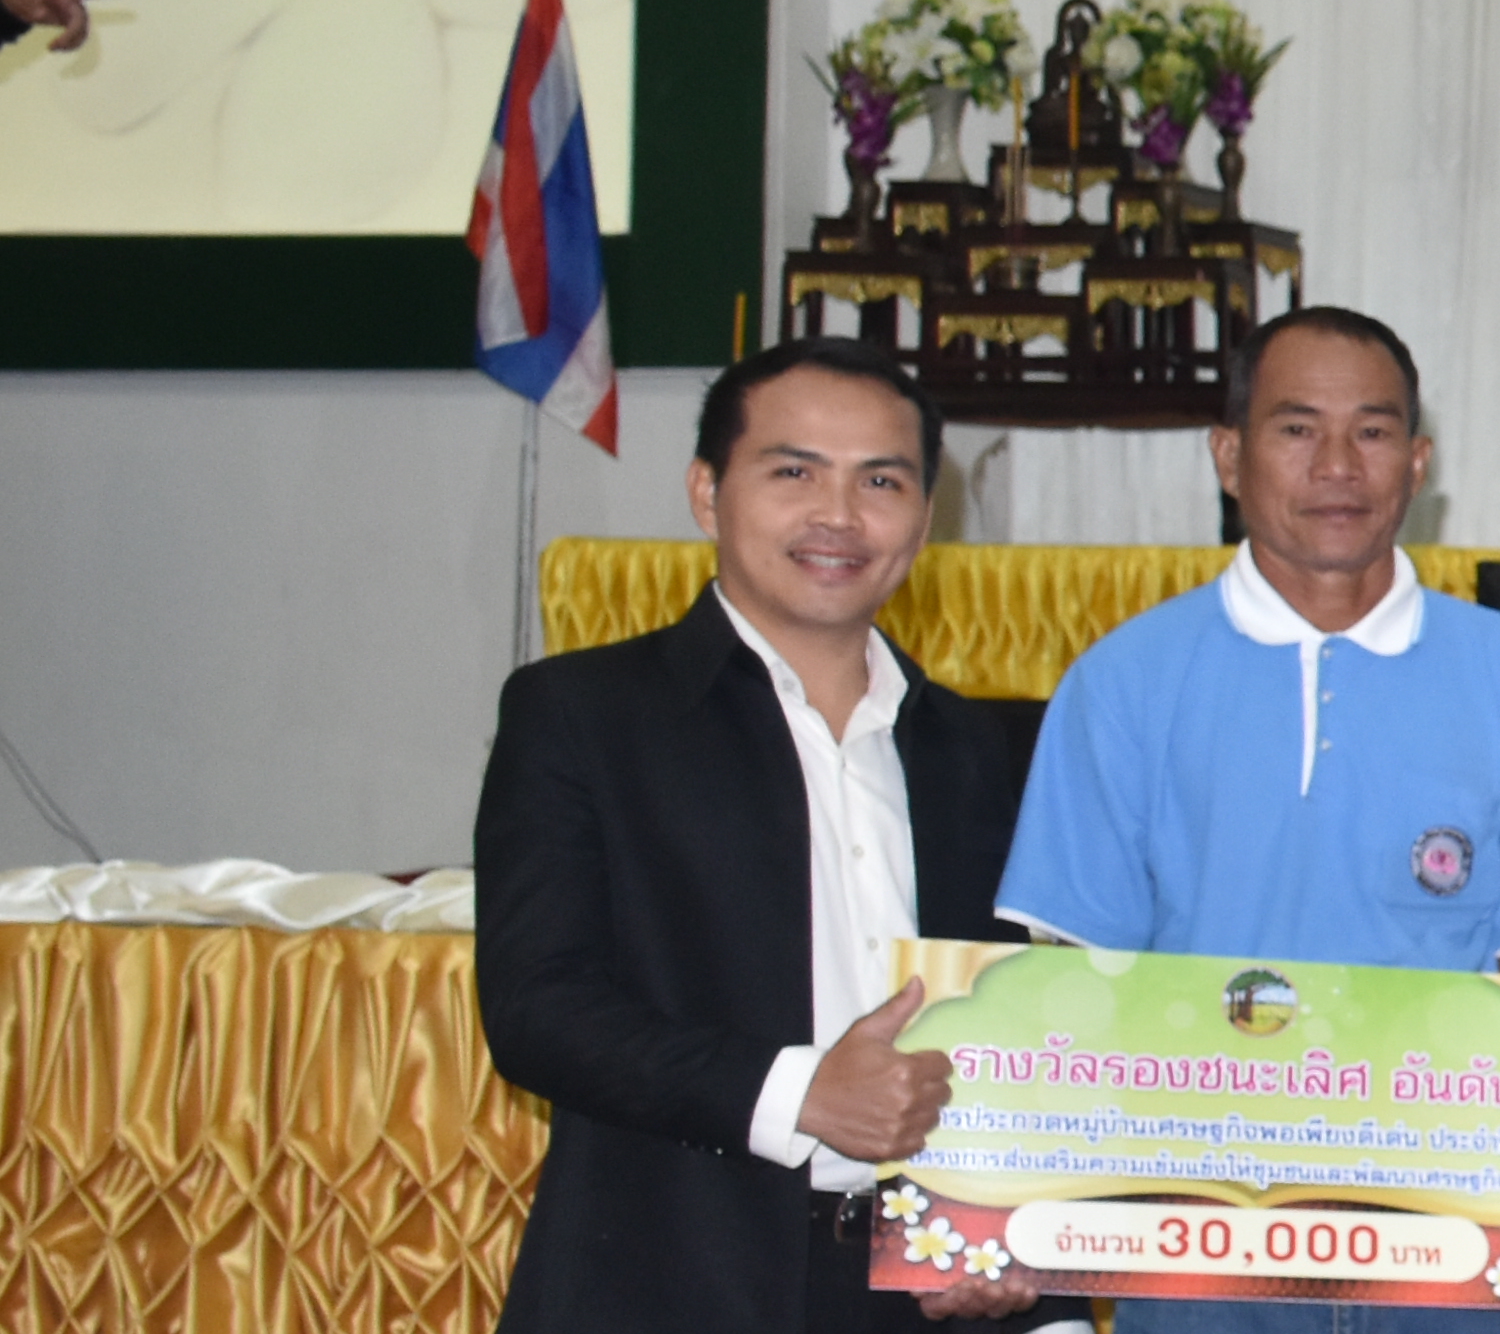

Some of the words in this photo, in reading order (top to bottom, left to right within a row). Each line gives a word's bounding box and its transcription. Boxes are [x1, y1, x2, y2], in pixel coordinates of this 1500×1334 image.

[954, 1035, 1369, 1098] รางวัลรองชนะเลิศ
[939, 1106, 1419, 1148] ารประกวดหมู่บ้านเศรษฐกิจพอเพียงดีเด่น
[1055, 1225, 1144, 1255] จำนวน
[1157, 1217, 1380, 1267] 30,000
[1389, 1245, 1442, 1266] บาท
